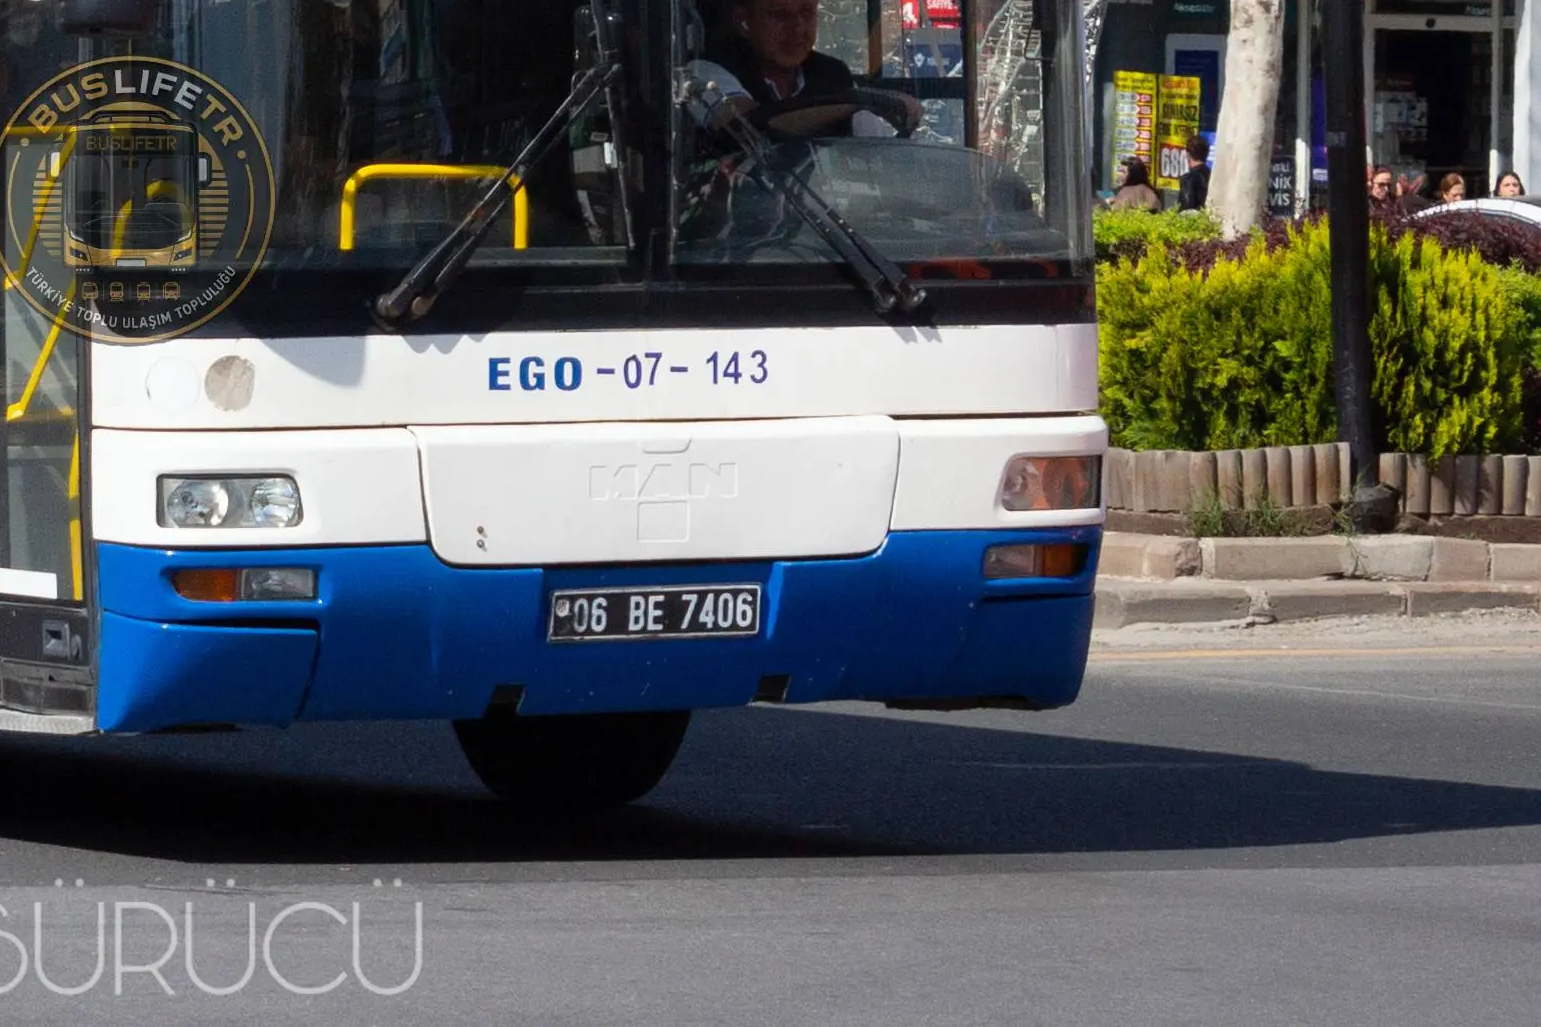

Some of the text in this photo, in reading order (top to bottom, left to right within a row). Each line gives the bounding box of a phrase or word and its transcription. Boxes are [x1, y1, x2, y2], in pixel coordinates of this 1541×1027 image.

[590, 461, 739, 501] MAN
[573, 591, 754, 633] 06 BE 7406
